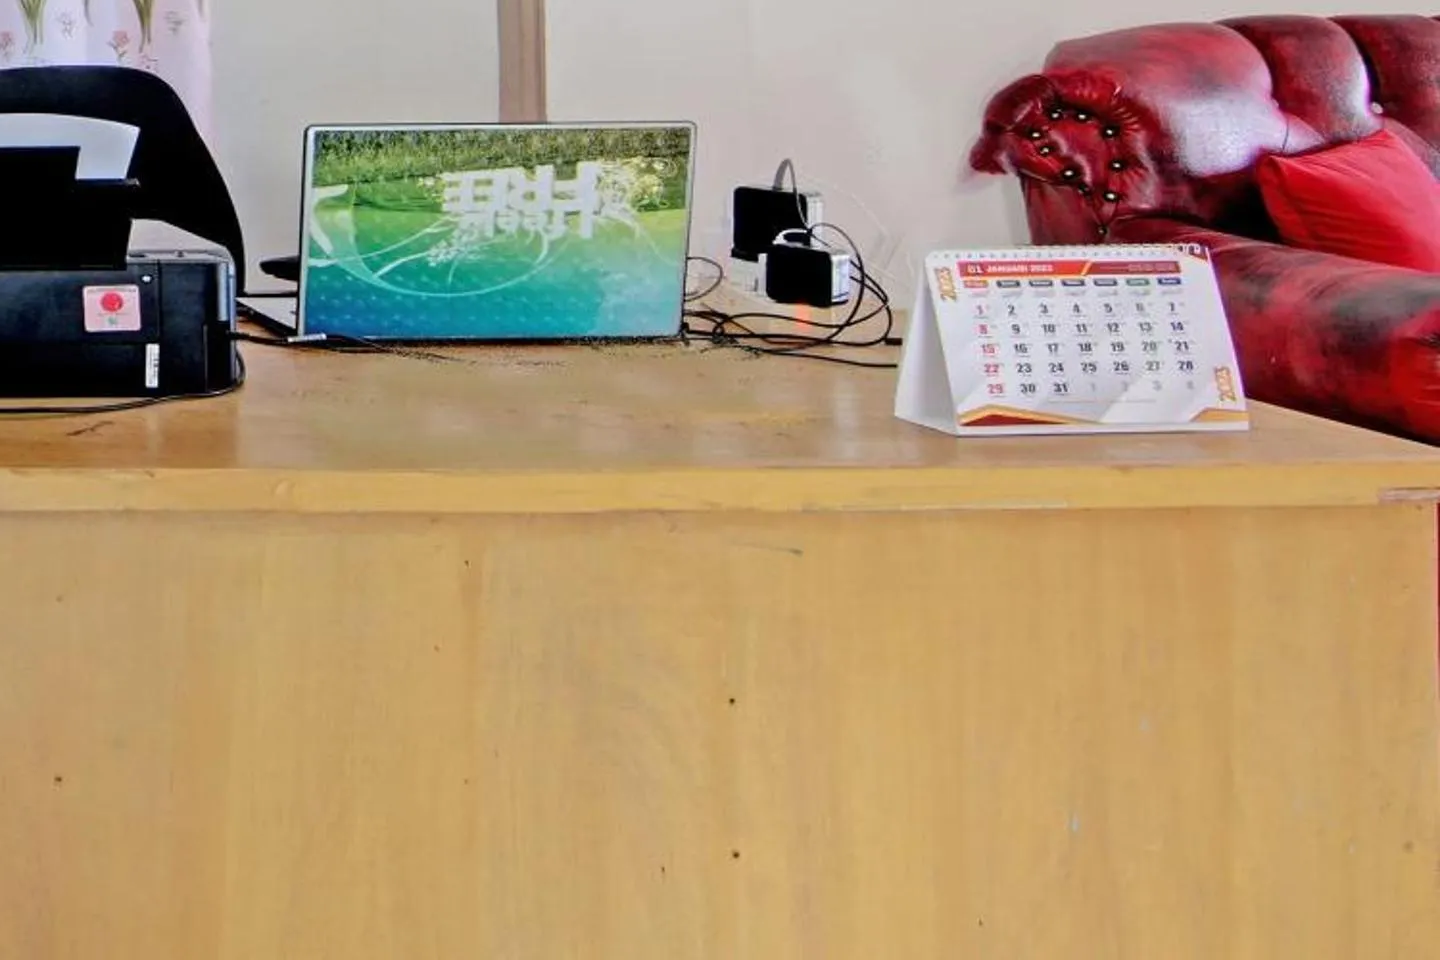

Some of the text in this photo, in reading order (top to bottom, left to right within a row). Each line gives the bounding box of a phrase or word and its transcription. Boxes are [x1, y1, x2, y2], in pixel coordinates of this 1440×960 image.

[441, 160, 599, 214] FREE
[1042, 324, 1056, 333] 10
[1076, 324, 1088, 333] 11
[1107, 322, 1120, 333] 12
[1139, 322, 1152, 332] 13
[1170, 321, 1184, 331] 14
[1014, 343, 1028, 354] 16
[1047, 343, 1059, 354] 17
[1078, 343, 1092, 353] 18
[1111, 342, 1125, 352] 19
[1142, 341, 1157, 352] 20
[1175, 341, 1189, 351] 21
[984, 360, 1193, 373] 22 23 24 25 26 27 28
[987, 383, 1004, 394] 29
[1020, 383, 1036, 394] 30
[1053, 382, 1069, 393] 31
